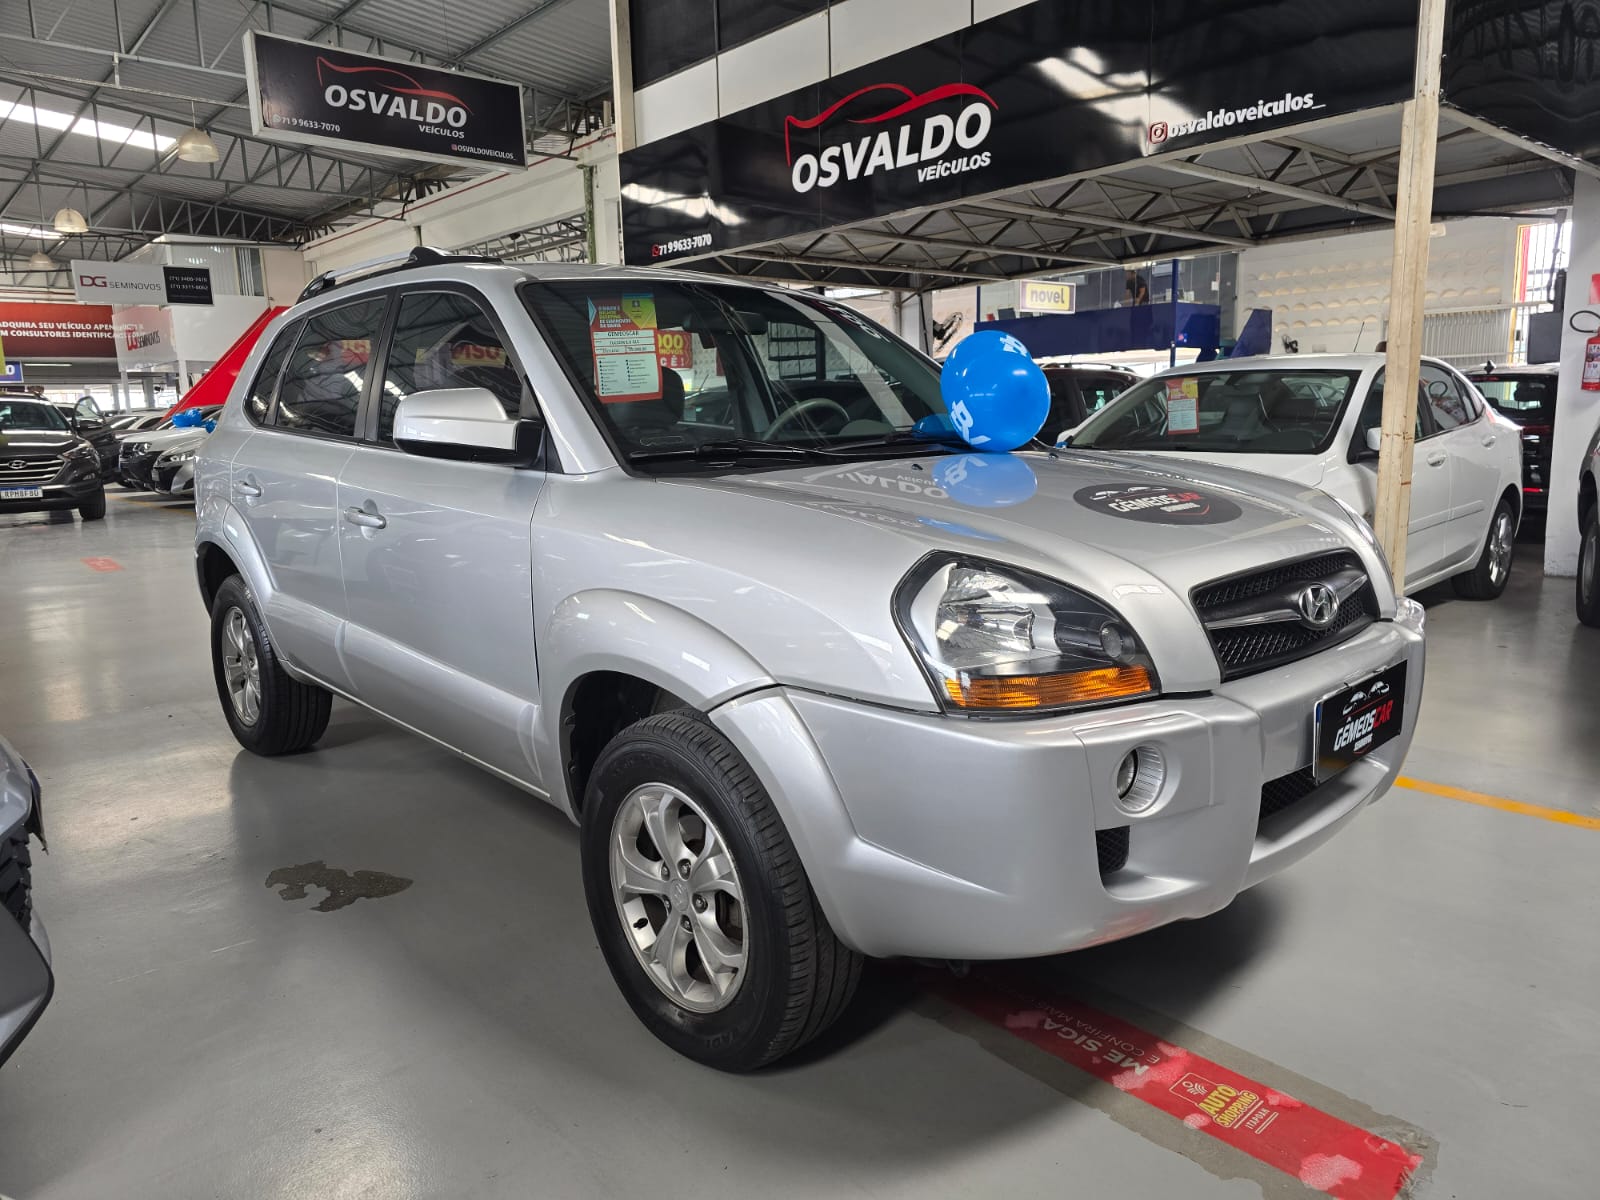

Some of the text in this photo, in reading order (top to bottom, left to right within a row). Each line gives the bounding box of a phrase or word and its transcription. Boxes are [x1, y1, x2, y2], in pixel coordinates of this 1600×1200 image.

[324, 84, 467, 128] OSVALDO
[299, 119, 341, 133] 9633-7070
[418, 124, 465, 139] VEÍCULOS
[791, 102, 993, 193] OSVALDO
[917, 151, 992, 183] VEÍCULOS
[80, 275, 161, 291] DG SEMINOVOS
[1030, 287, 1065, 304] novel
[0, 322, 37, 330] ADQUIRA
[56, 321, 92, 330] VEÍCULO
[10, 329, 71, 338] CONSULTORES
[1108, 492, 1204, 512] GÊMEOSCAR
[1333, 700, 1394, 751] GÊMEOSCAR
[1043, 1018, 1150, 1076] ME SIGA
[1076, 1020, 1145, 1057] CONFIRA
[1147, 1054, 1161, 1064] E
[1199, 1085, 1237, 1115] AUTO
[1216, 1092, 1257, 1127] SHOPPING
